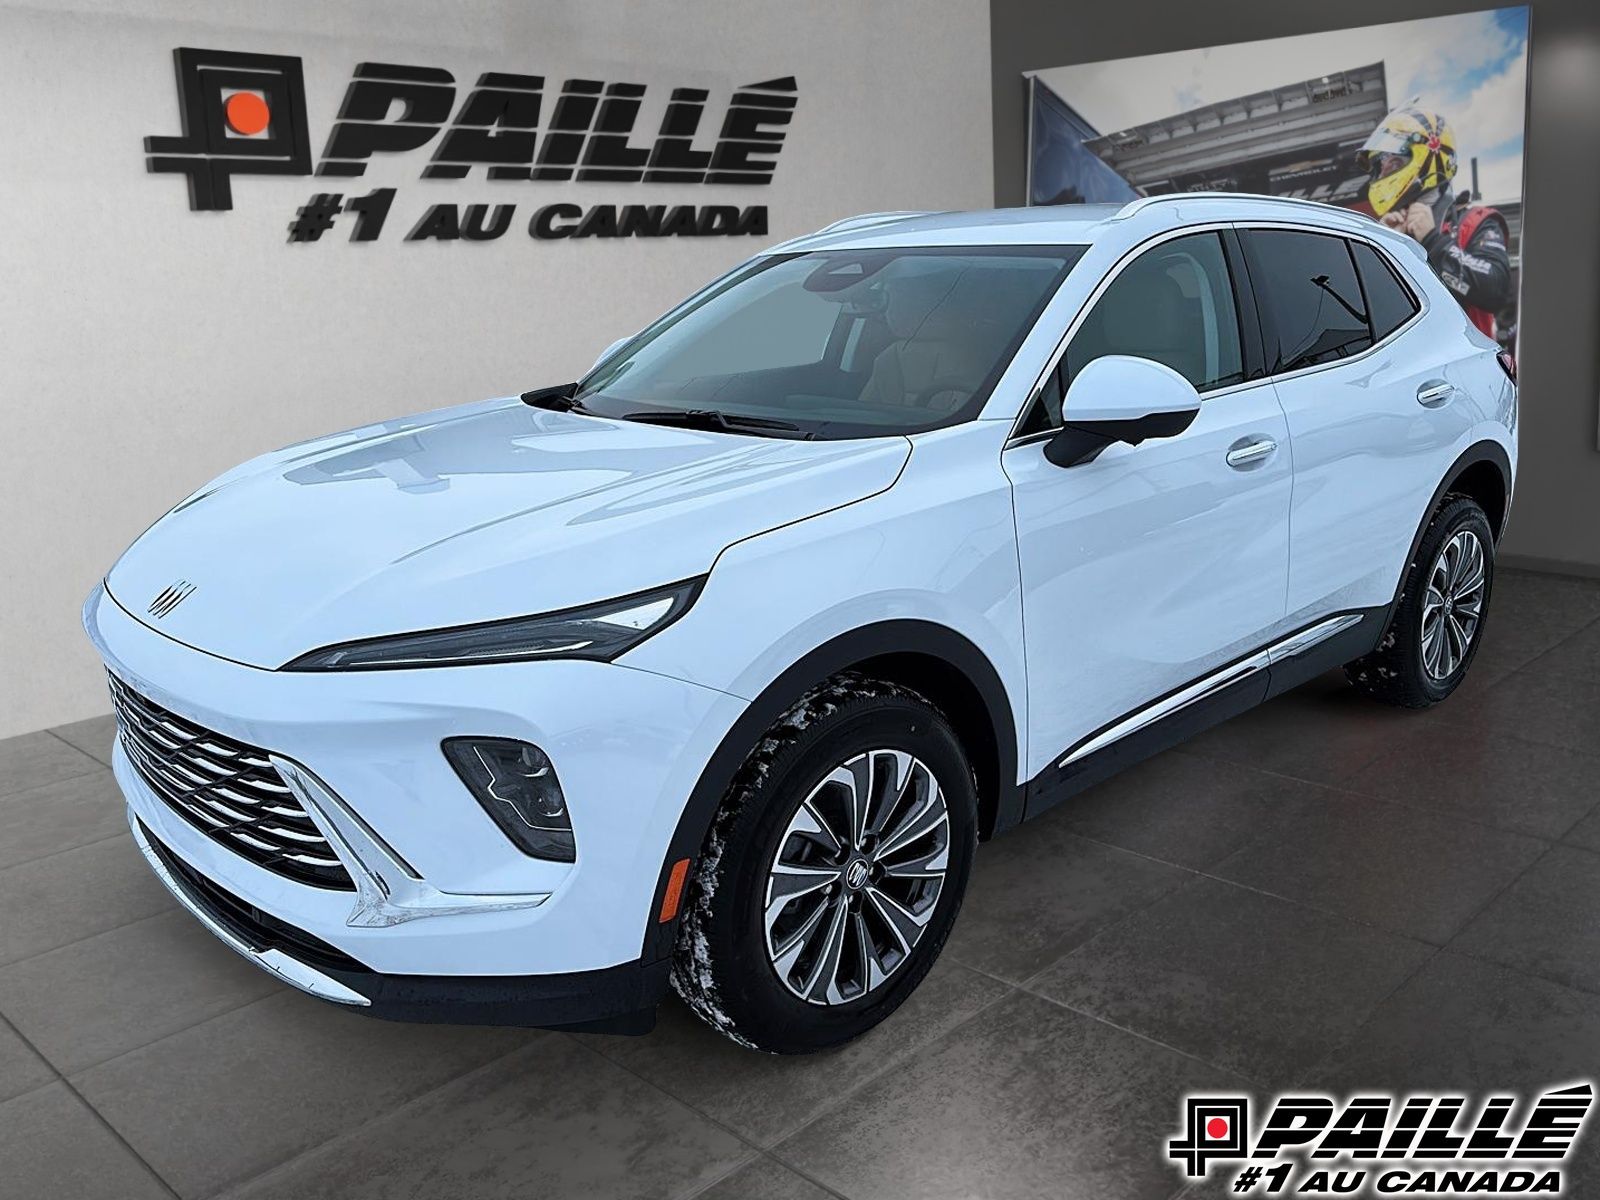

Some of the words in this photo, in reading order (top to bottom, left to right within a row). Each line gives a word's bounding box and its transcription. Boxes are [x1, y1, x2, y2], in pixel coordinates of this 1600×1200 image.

[313, 61, 798, 185] PAILLÉ
[287, 187, 397, 243] #1
[403, 203, 514, 241] AU
[528, 203, 769, 240] CANADA
